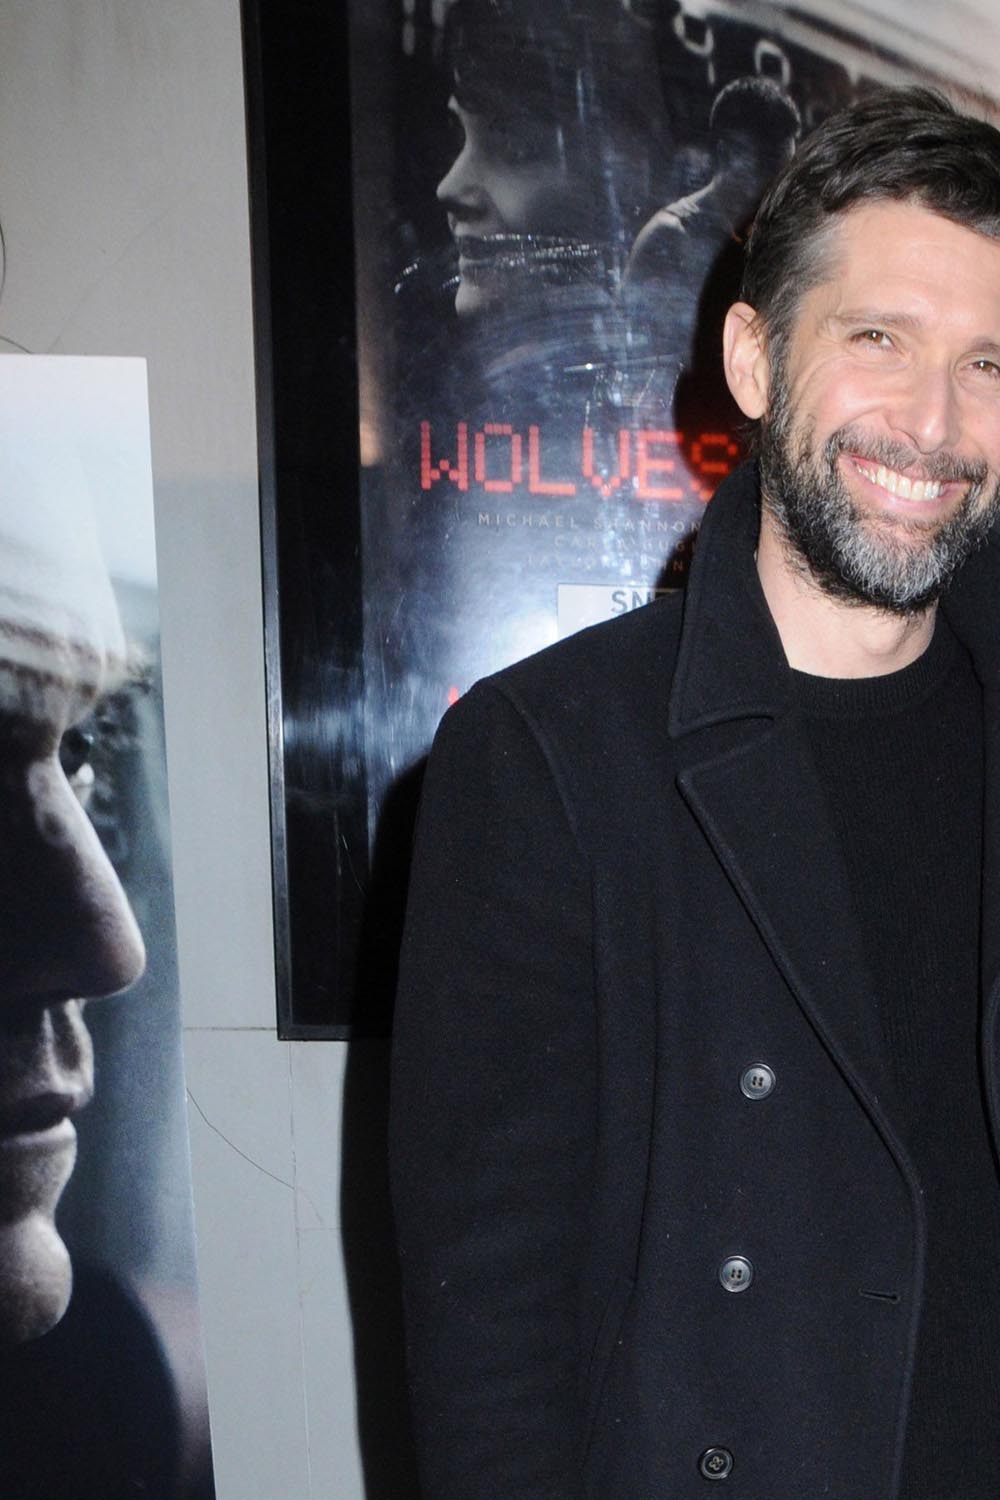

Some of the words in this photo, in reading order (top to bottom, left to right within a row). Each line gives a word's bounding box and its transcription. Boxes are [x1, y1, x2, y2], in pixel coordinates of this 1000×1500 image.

[421, 420, 738, 502] WOLVES
[478, 512, 578, 528] MICHAEL
[612, 590, 658, 613] SN
